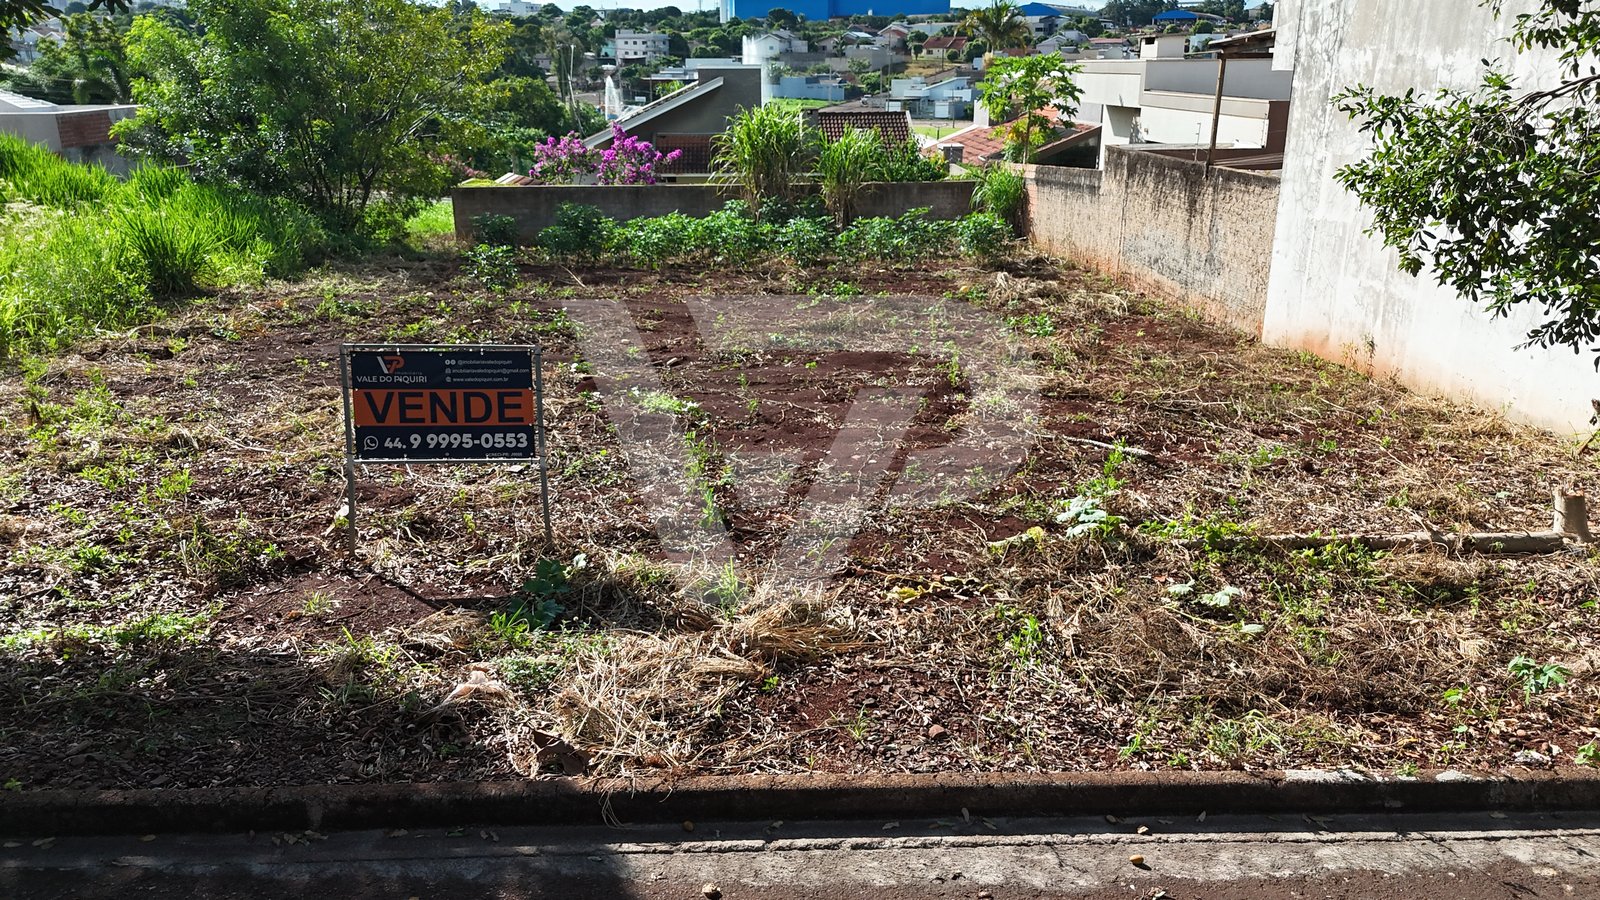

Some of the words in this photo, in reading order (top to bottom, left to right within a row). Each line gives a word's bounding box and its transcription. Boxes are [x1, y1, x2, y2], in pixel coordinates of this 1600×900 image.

[356, 375, 378, 383] VALE
[380, 375, 393, 383] DO
[394, 375, 428, 384] PIQUIRI
[364, 391, 524, 424] VENDE
[426, 433, 528, 449] 9995-0553
